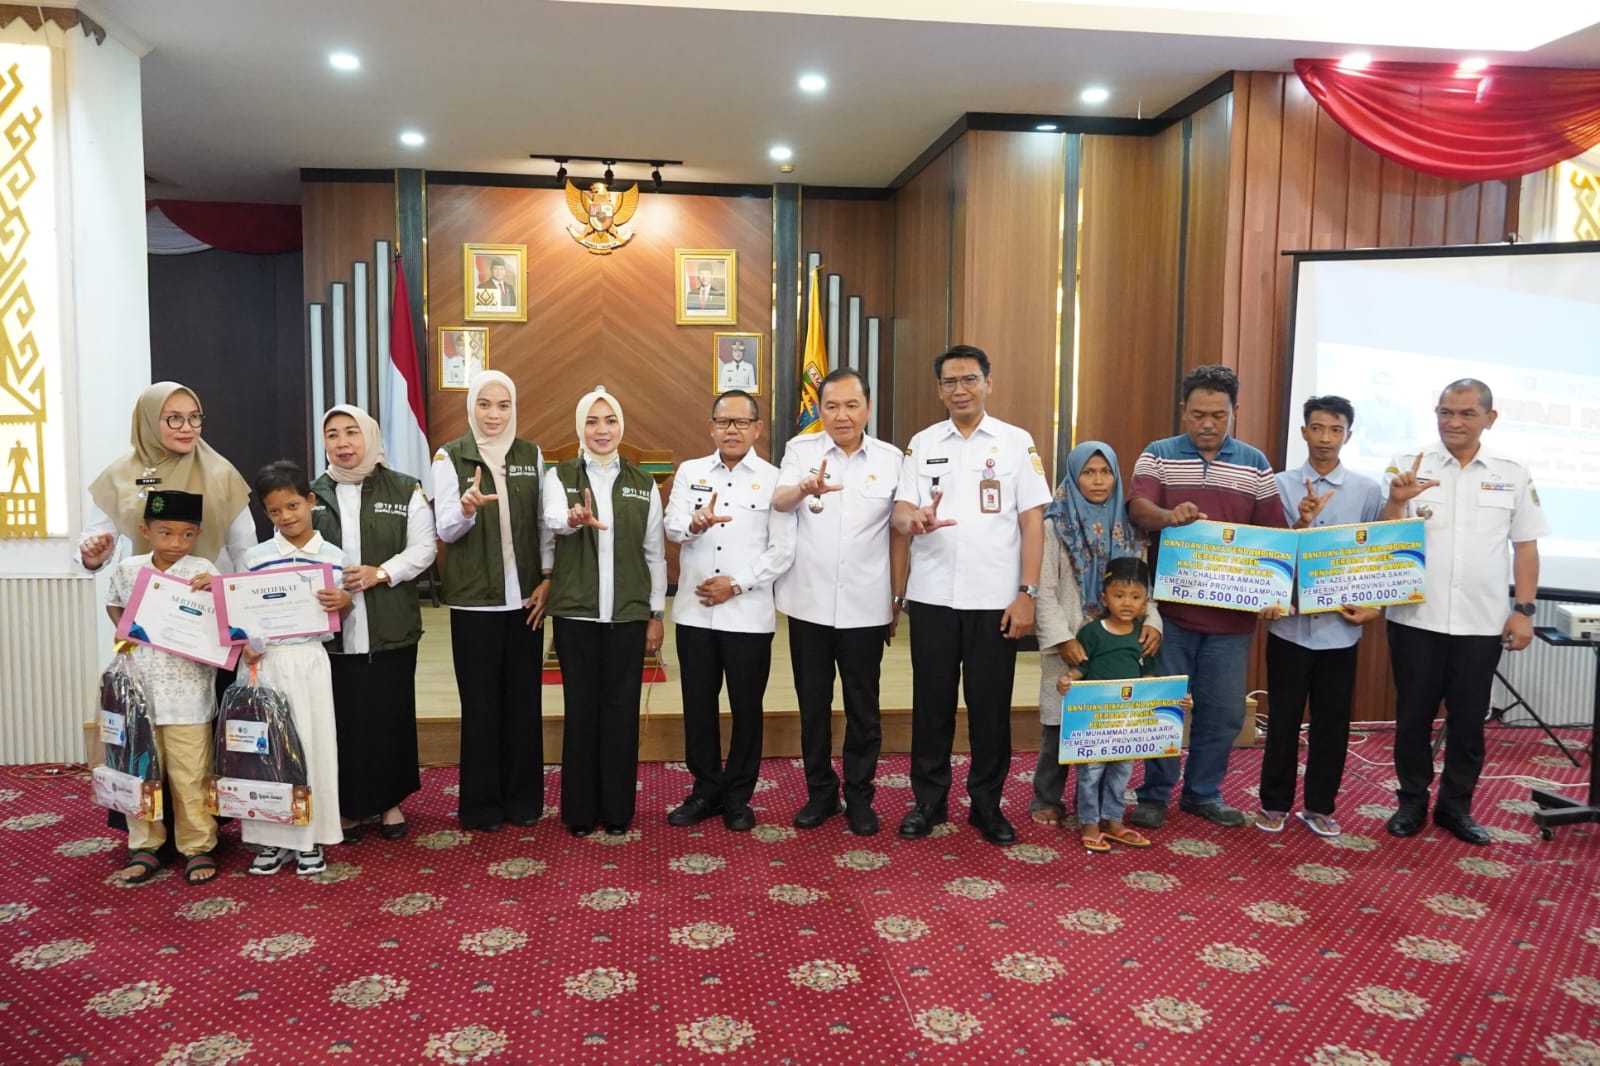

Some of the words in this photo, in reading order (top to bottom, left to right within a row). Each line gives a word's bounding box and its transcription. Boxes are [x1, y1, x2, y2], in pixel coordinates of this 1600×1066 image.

[1164, 538, 1201, 549] BANTUAN
[1204, 544, 1225, 552] BIAYA
[1227, 546, 1292, 560] PENDAMPINGAN
[1303, 550, 1338, 559] BANTUAN
[1340, 547, 1360, 556] BIAYA
[1362, 542, 1421, 554] PENDAMPINGAN
[1192, 553, 1227, 563] BEROBAT
[1231, 557, 1260, 566] PASIEN
[1331, 557, 1364, 566] BEROBAT
[1368, 554, 1394, 562] PASIEN
[1206, 563, 1242, 574] JANTUNG
[1346, 565, 1382, 574] JANTUNG
[1193, 570, 1235, 581] CHALLISTA
[1237, 576, 1271, 586] AMANDA
[1330, 575, 1356, 583] AZELEA
[251, 584, 297, 595] SERTIFIKAT
[1160, 576, 1208, 588] PEMERINTAH
[1210, 583, 1247, 593] PROVINSI
[1249, 587, 1288, 598] LAMPUNG
[1304, 585, 1349, 595] PEMERINTAH
[1351, 582, 1385, 590] PROVINSI
[1387, 578, 1423, 586] LAMPUNG
[1172, 586, 1192, 599] Rp.
[1317, 596, 1336, 606] Rp.
[1067, 703, 1102, 712] BANTUAN
[1094, 712, 1128, 720] BEROBAT
[1086, 729, 1128, 737] MUHAMMAD
[1129, 727, 1157, 735] ARJUNA
[1064, 738, 1110, 747] PEMERINTAH
[1077, 748, 1096, 758] Rp.
